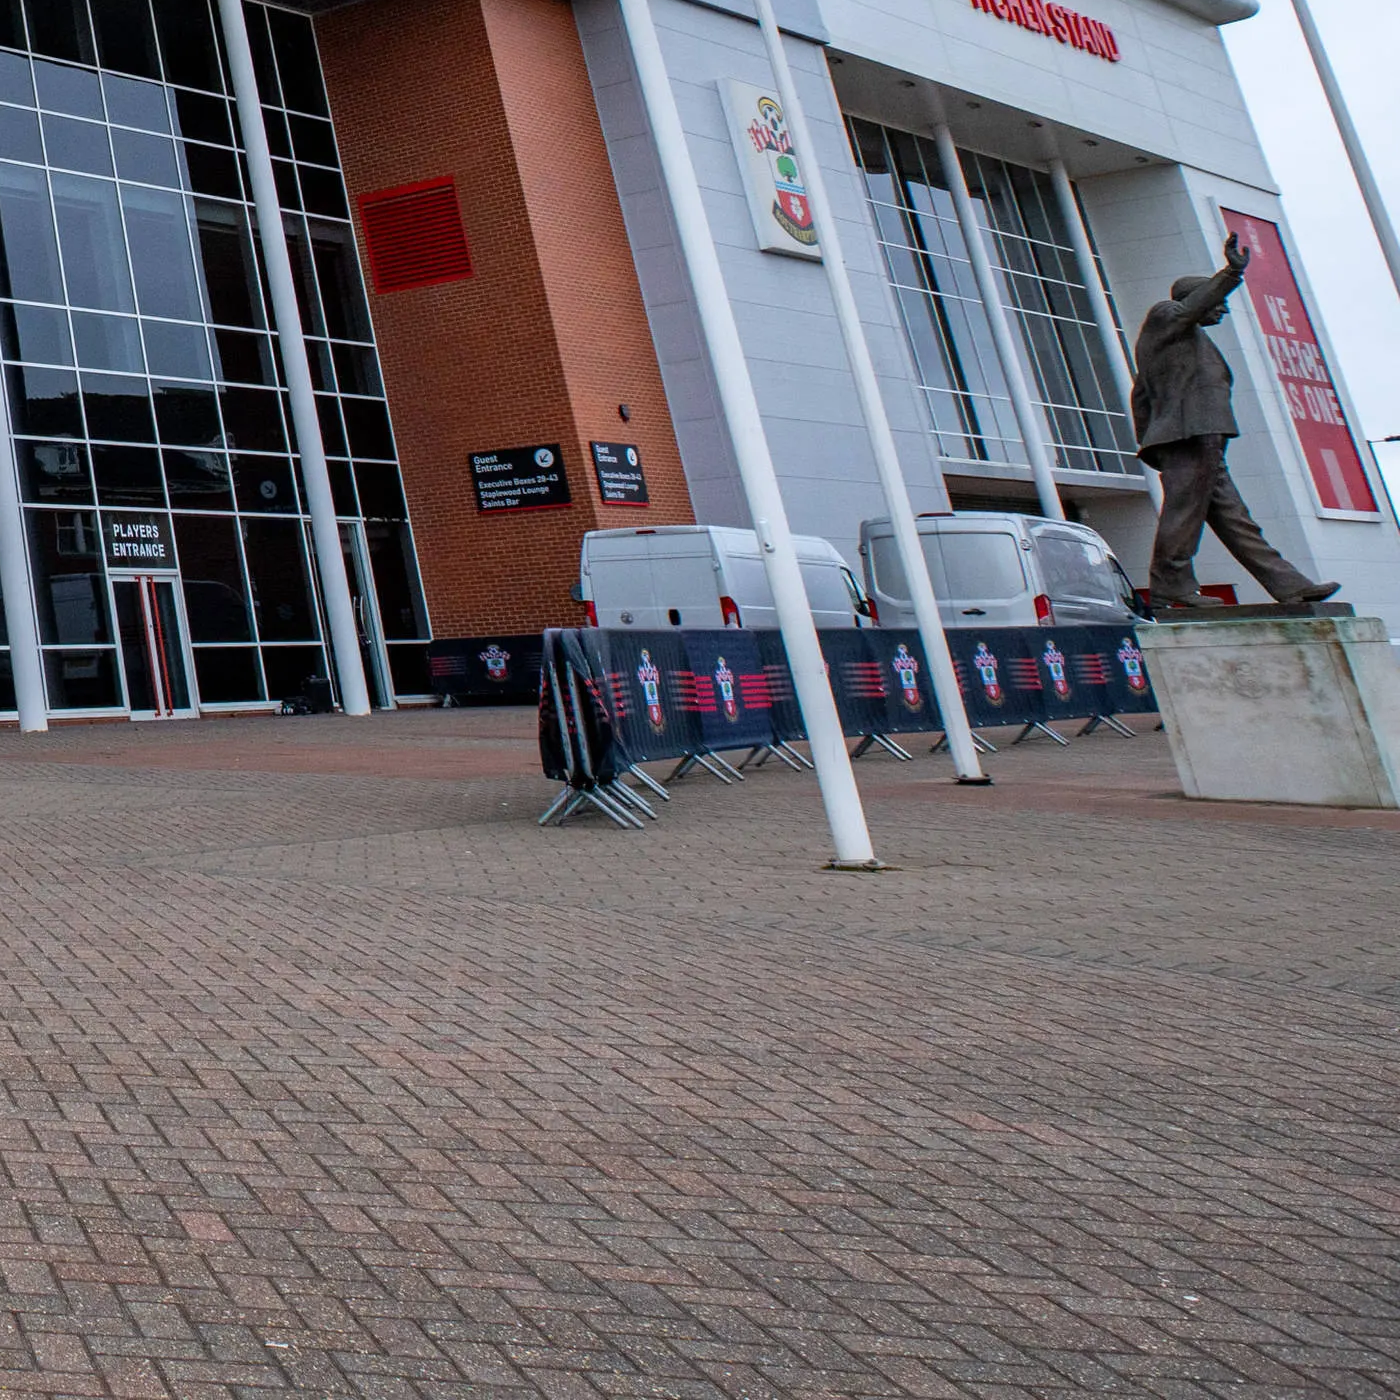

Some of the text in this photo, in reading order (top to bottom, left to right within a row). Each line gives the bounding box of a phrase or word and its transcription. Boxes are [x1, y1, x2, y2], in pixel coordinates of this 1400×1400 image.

[1045, 2, 1121, 62] STAND
[1264, 294, 1297, 335] WE
[1303, 384, 1346, 426] ONE
[473, 455, 498, 464] Guest
[475, 462, 513, 473] Entrance
[478, 480, 513, 489] Executive
[513, 477, 536, 485] Boxes
[480, 486, 550, 499] Staplewood Lounge
[482, 498, 520, 508] Saints Bar
[112, 523, 159, 538] PLAYERS
[112, 542, 166, 557] ENTRANCE
